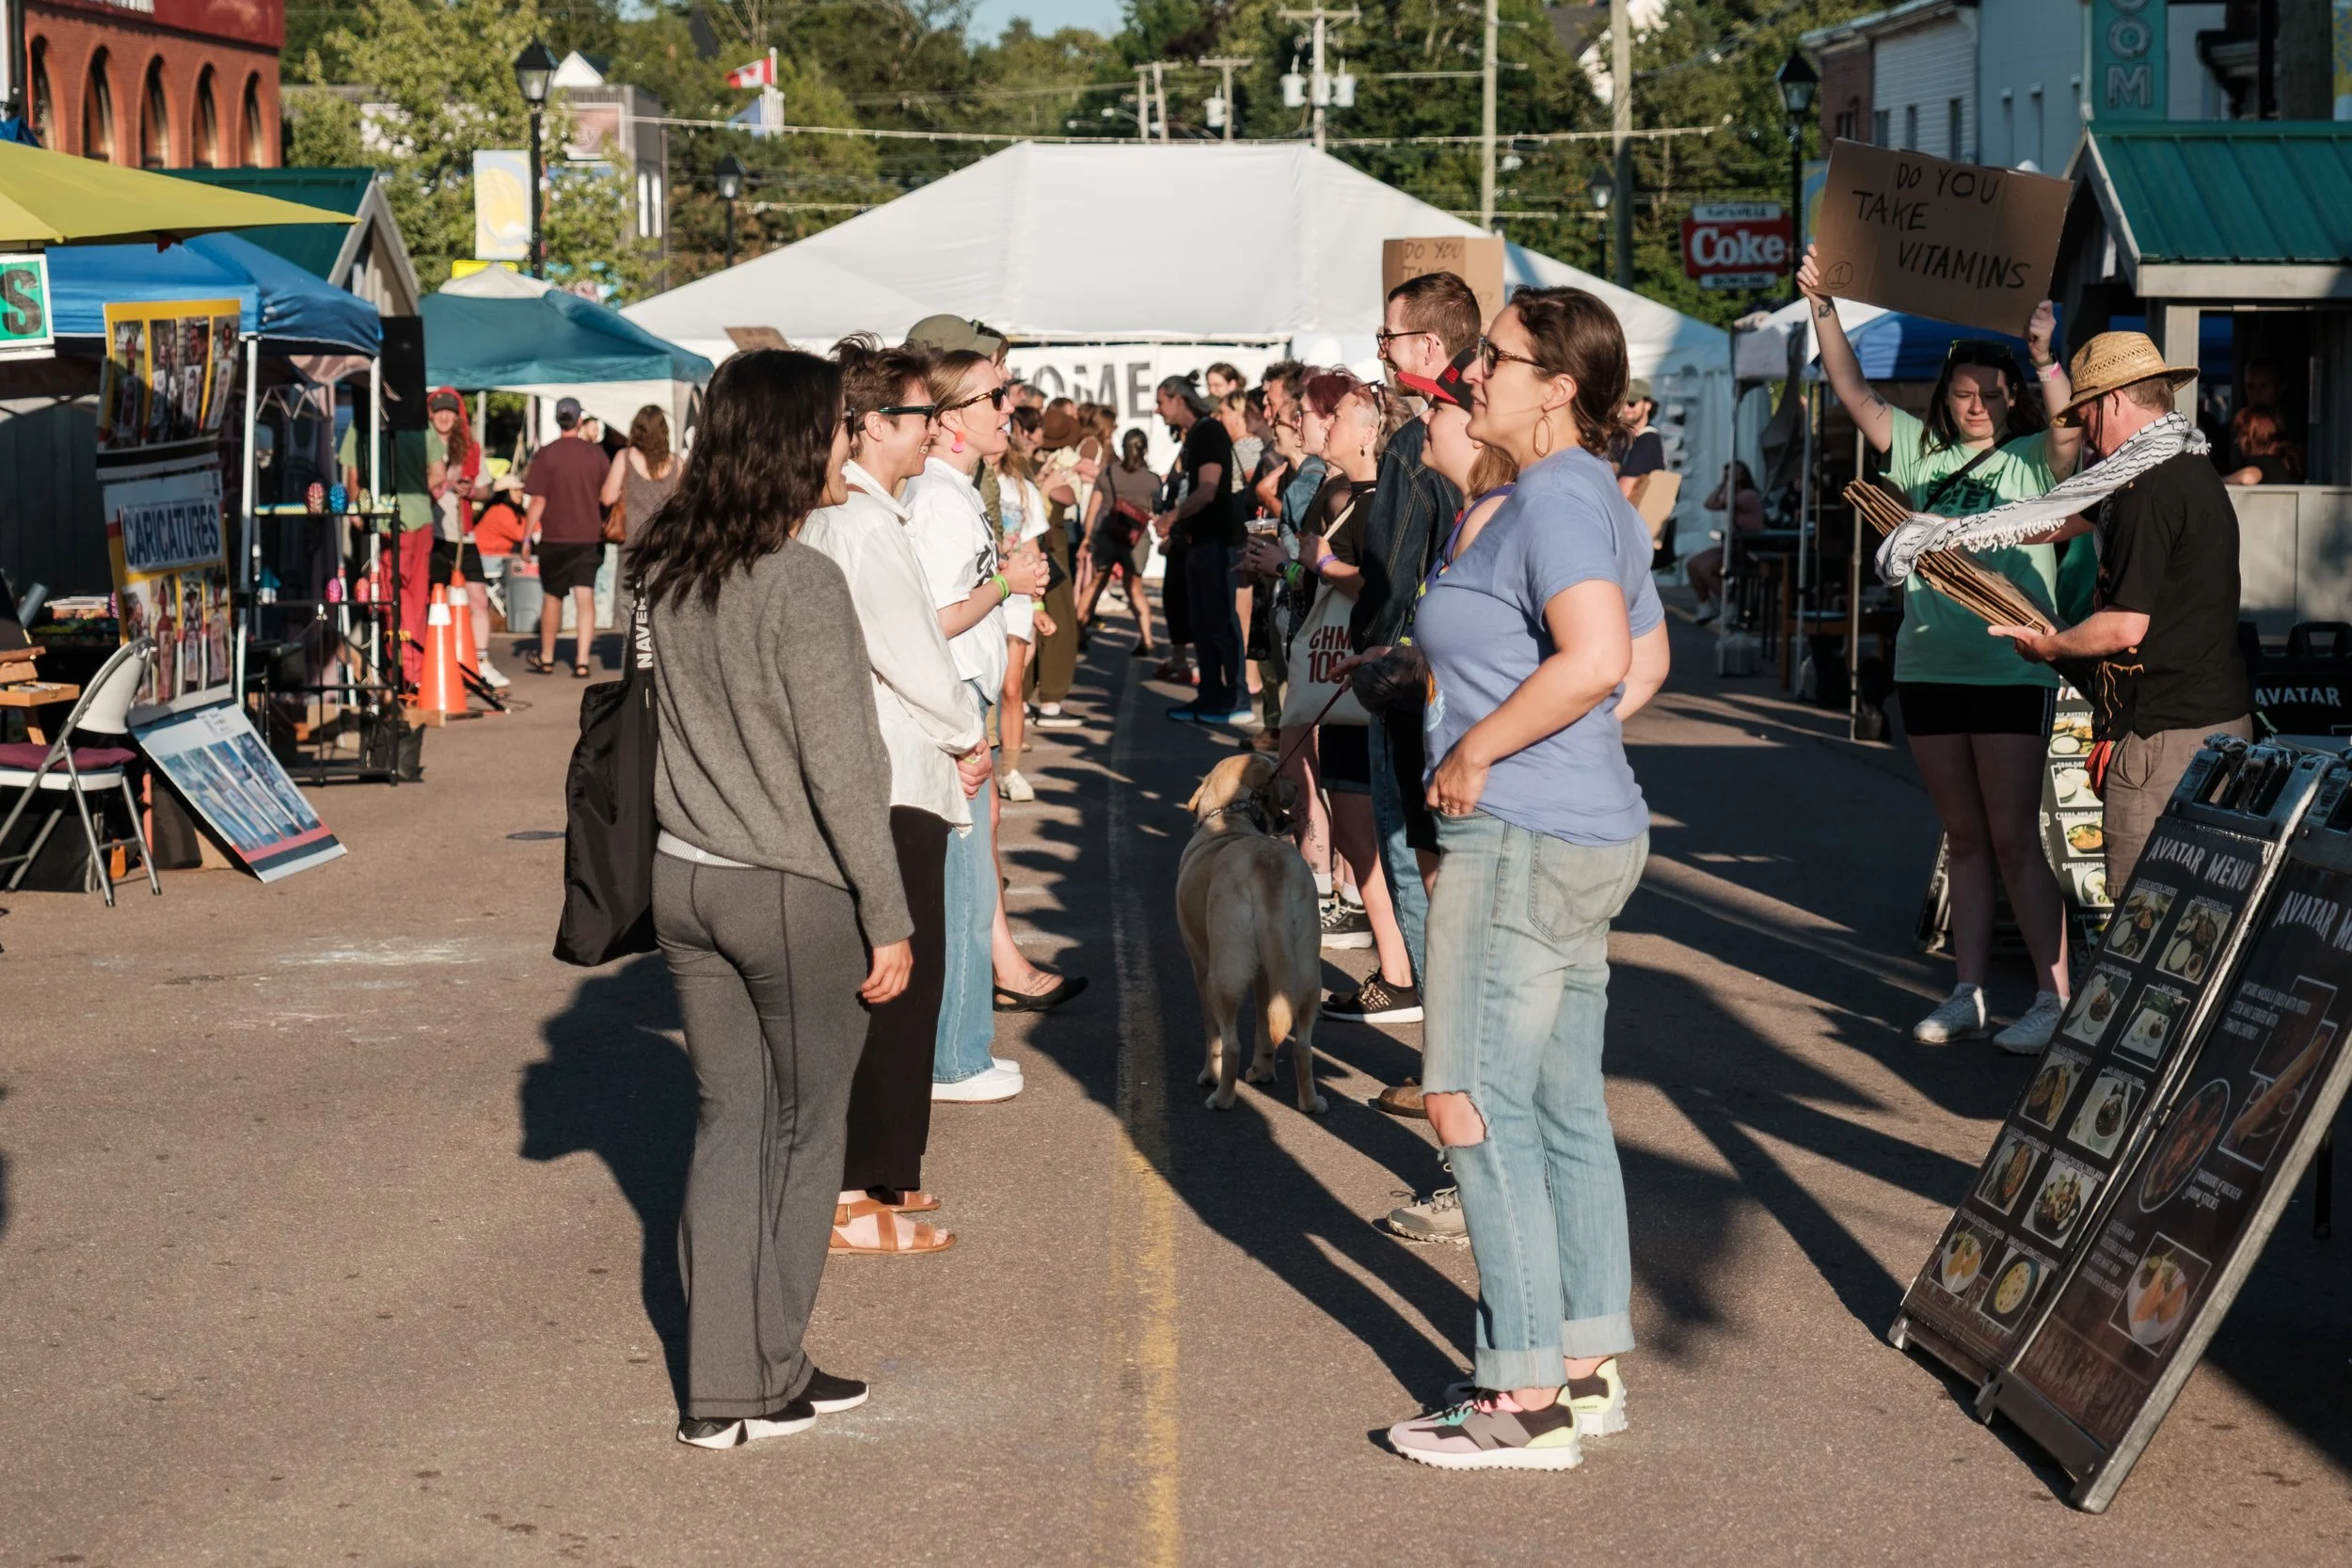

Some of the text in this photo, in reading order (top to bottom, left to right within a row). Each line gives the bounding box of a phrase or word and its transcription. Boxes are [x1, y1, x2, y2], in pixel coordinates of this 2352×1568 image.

[1897, 162, 2000, 204] DO YOU
[1852, 190, 1929, 231] TAKE
[1691, 226, 1786, 267] Coke
[1899, 240, 2031, 291] VITAMINS
[1011, 361, 1152, 419] OME
[122, 504, 219, 567] CARICATURES
[2254, 687, 2342, 707] AVATAR
[2145, 835, 2256, 892] AVATAR MENU
[2271, 890, 2339, 942] AVATAR
